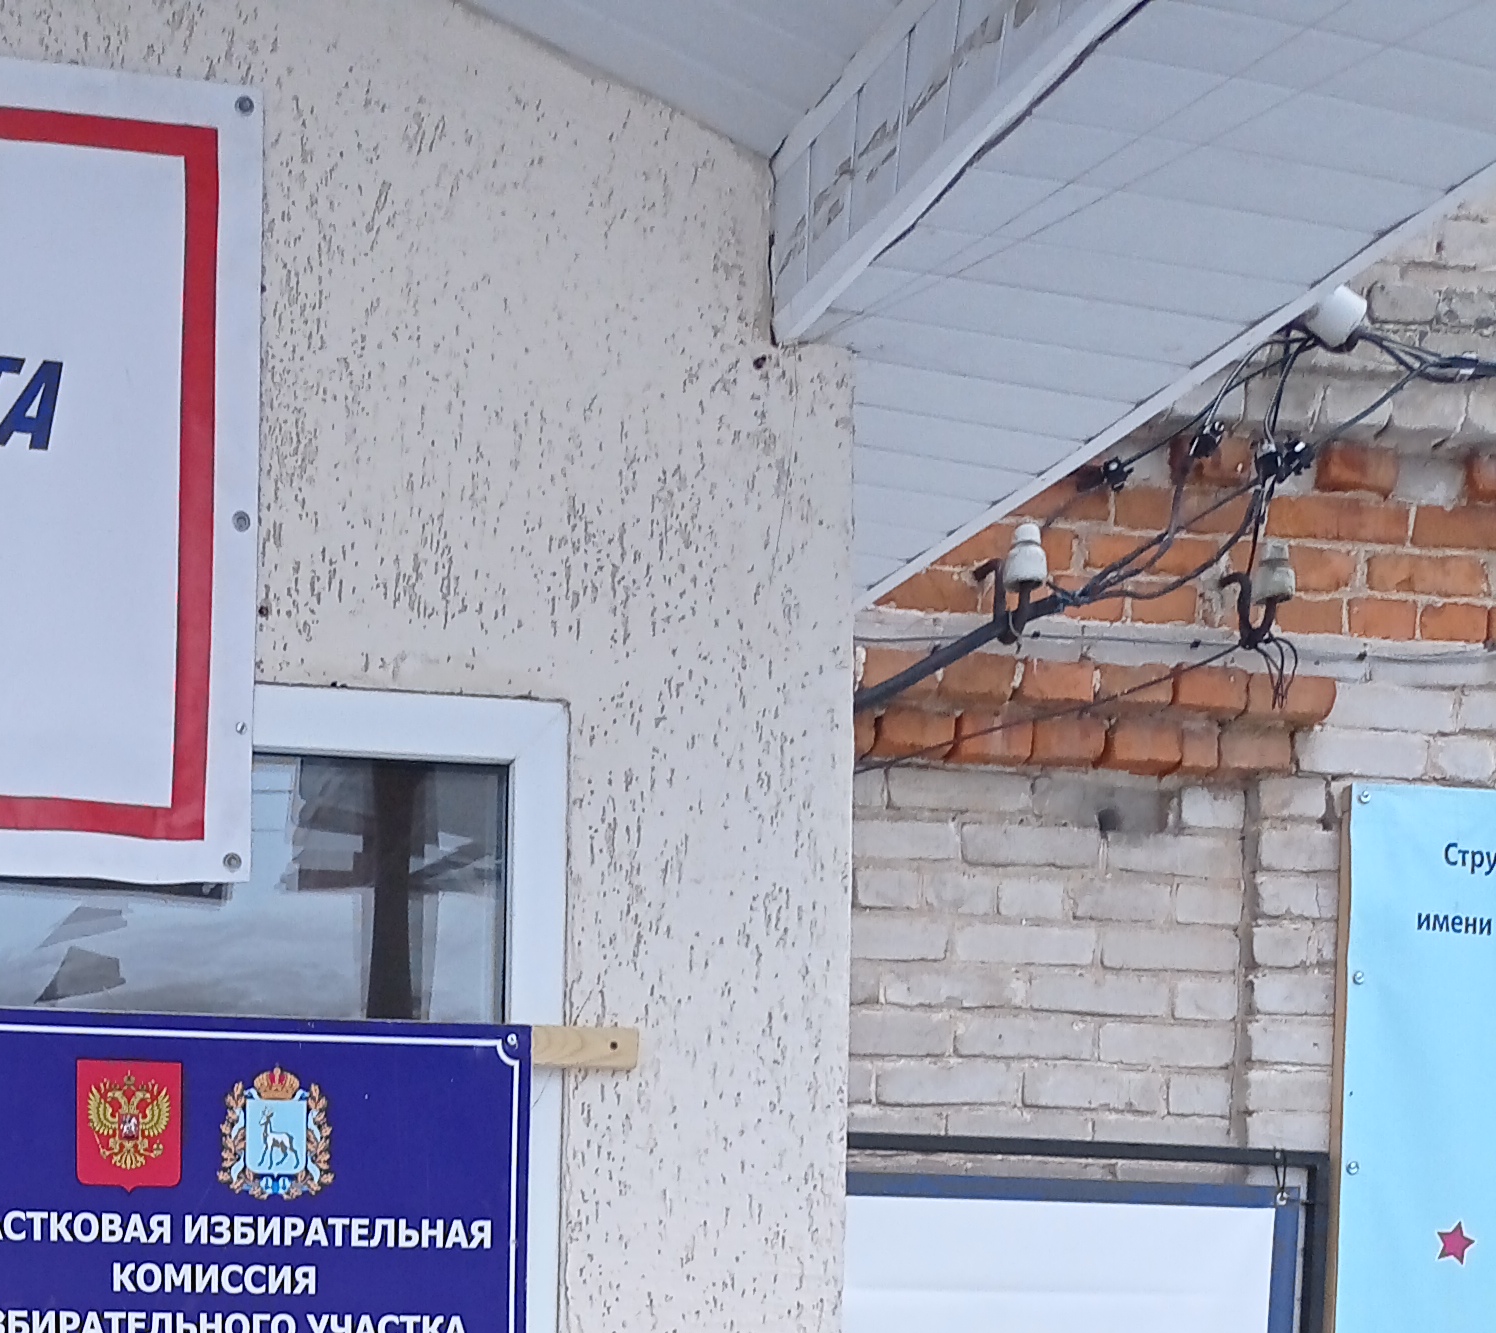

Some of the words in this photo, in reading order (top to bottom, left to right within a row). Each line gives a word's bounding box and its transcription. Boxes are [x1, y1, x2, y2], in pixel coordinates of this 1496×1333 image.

[1417, 912, 1493, 936] имени
[183, 1214, 493, 1249] ИЗБИРАТЕЛЬНАЯ
[111, 1262, 317, 1296] КОМИССИЯ
